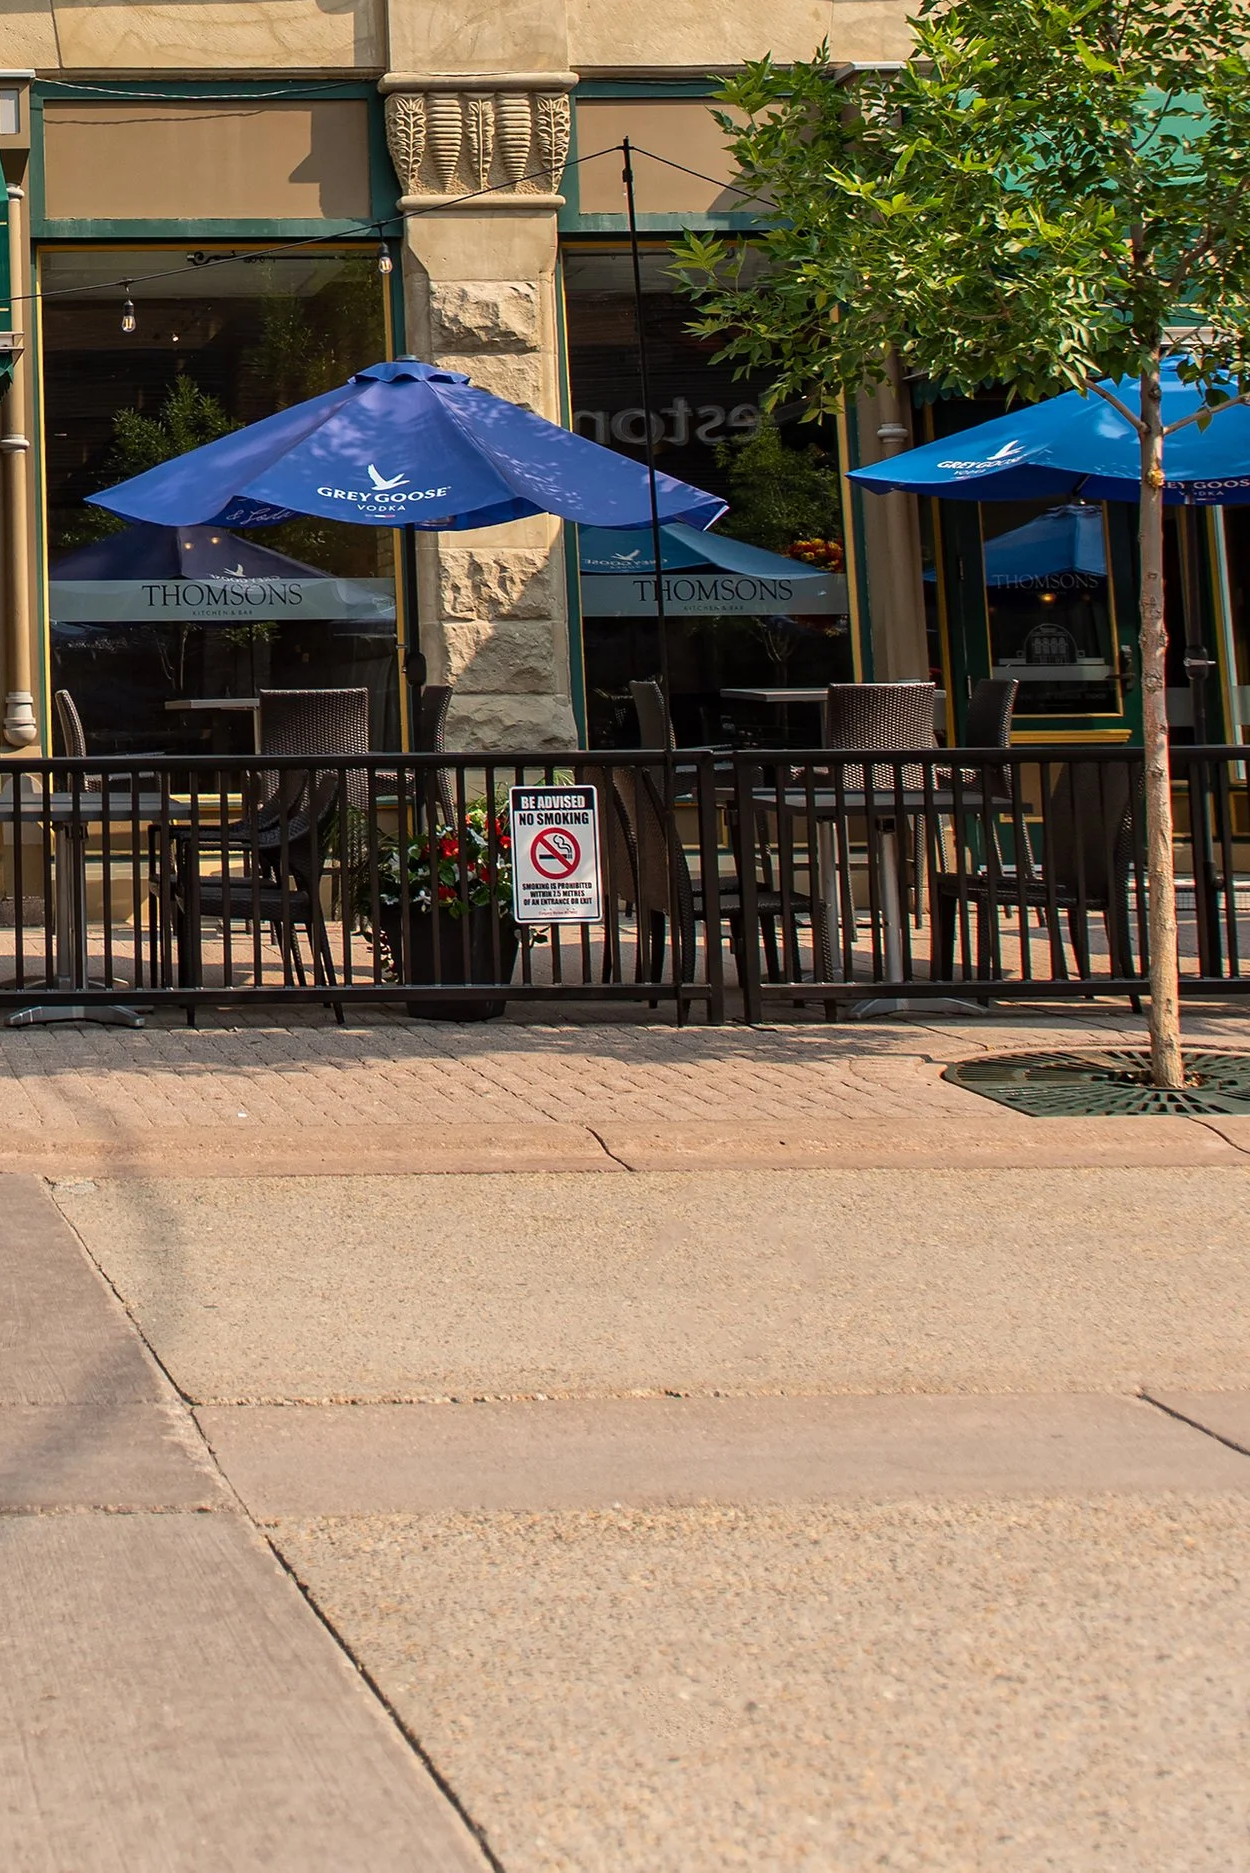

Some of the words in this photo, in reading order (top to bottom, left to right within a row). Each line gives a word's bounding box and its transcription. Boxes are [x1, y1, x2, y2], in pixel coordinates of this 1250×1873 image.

[317, 487, 373, 503] GREY
[374, 487, 448, 503] GOOSE
[357, 504, 405, 512] VODKA
[991, 574, 1099, 589] THOMSONS
[141, 584, 303, 607] THOMSONS
[633, 579, 793, 601] THOMSONS
[521, 796, 536, 809] BE
[538, 795, 585, 809] ADVISED
[519, 813, 534, 826] NO
[537, 812, 589, 825] SMOKING
